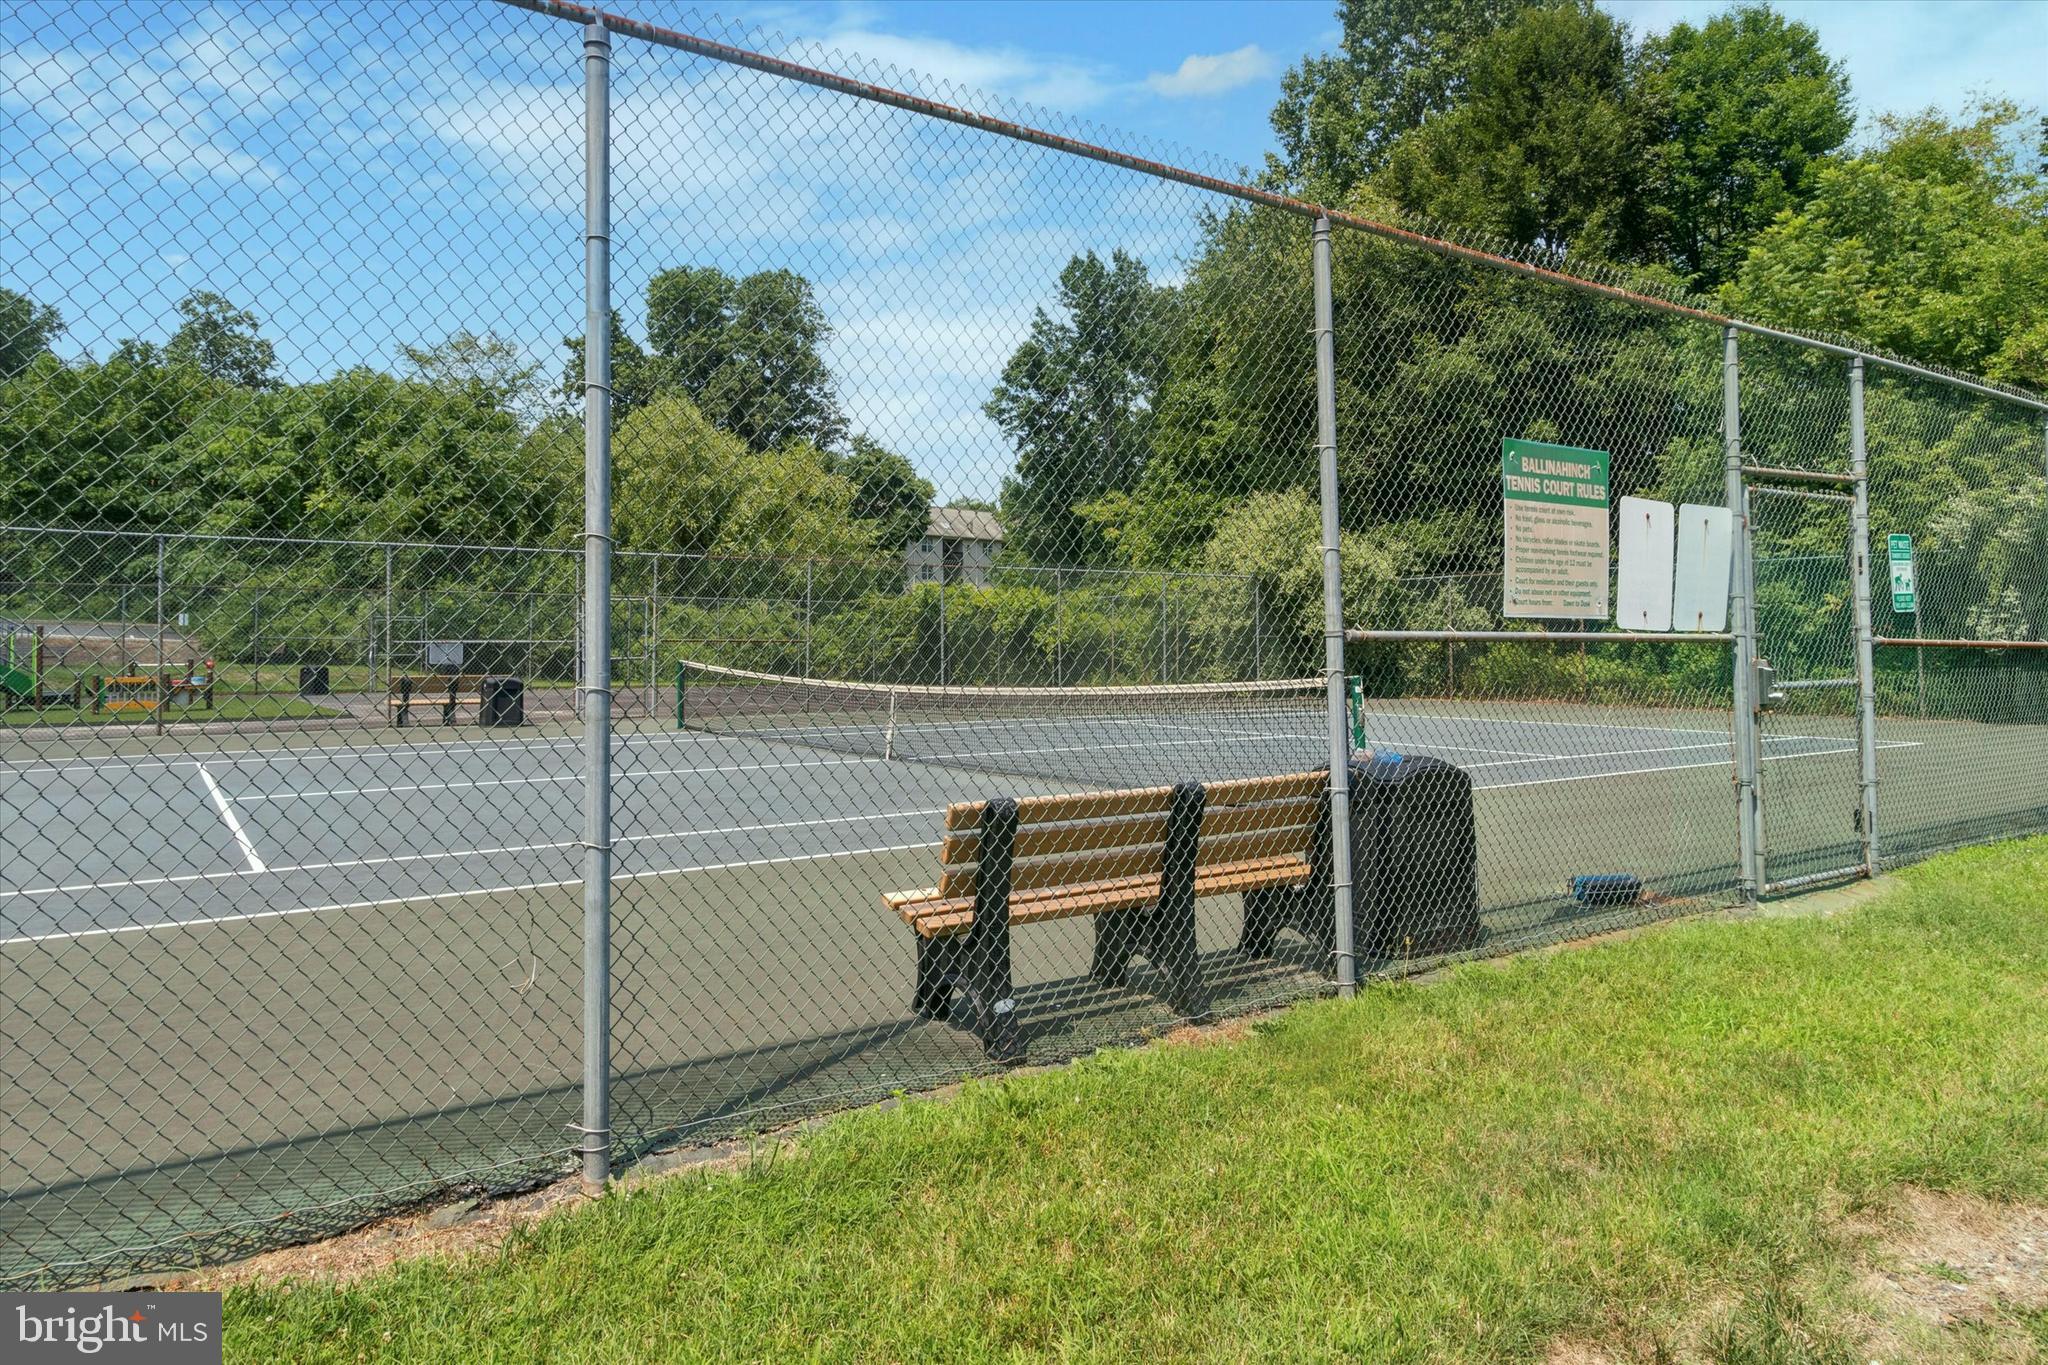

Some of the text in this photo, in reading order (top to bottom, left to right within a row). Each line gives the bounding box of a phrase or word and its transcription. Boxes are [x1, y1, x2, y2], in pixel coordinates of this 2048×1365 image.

[1521, 457, 1591, 479] BALLINAHINCH
[1506, 475, 1605, 500] TENNIS COURT RULES
